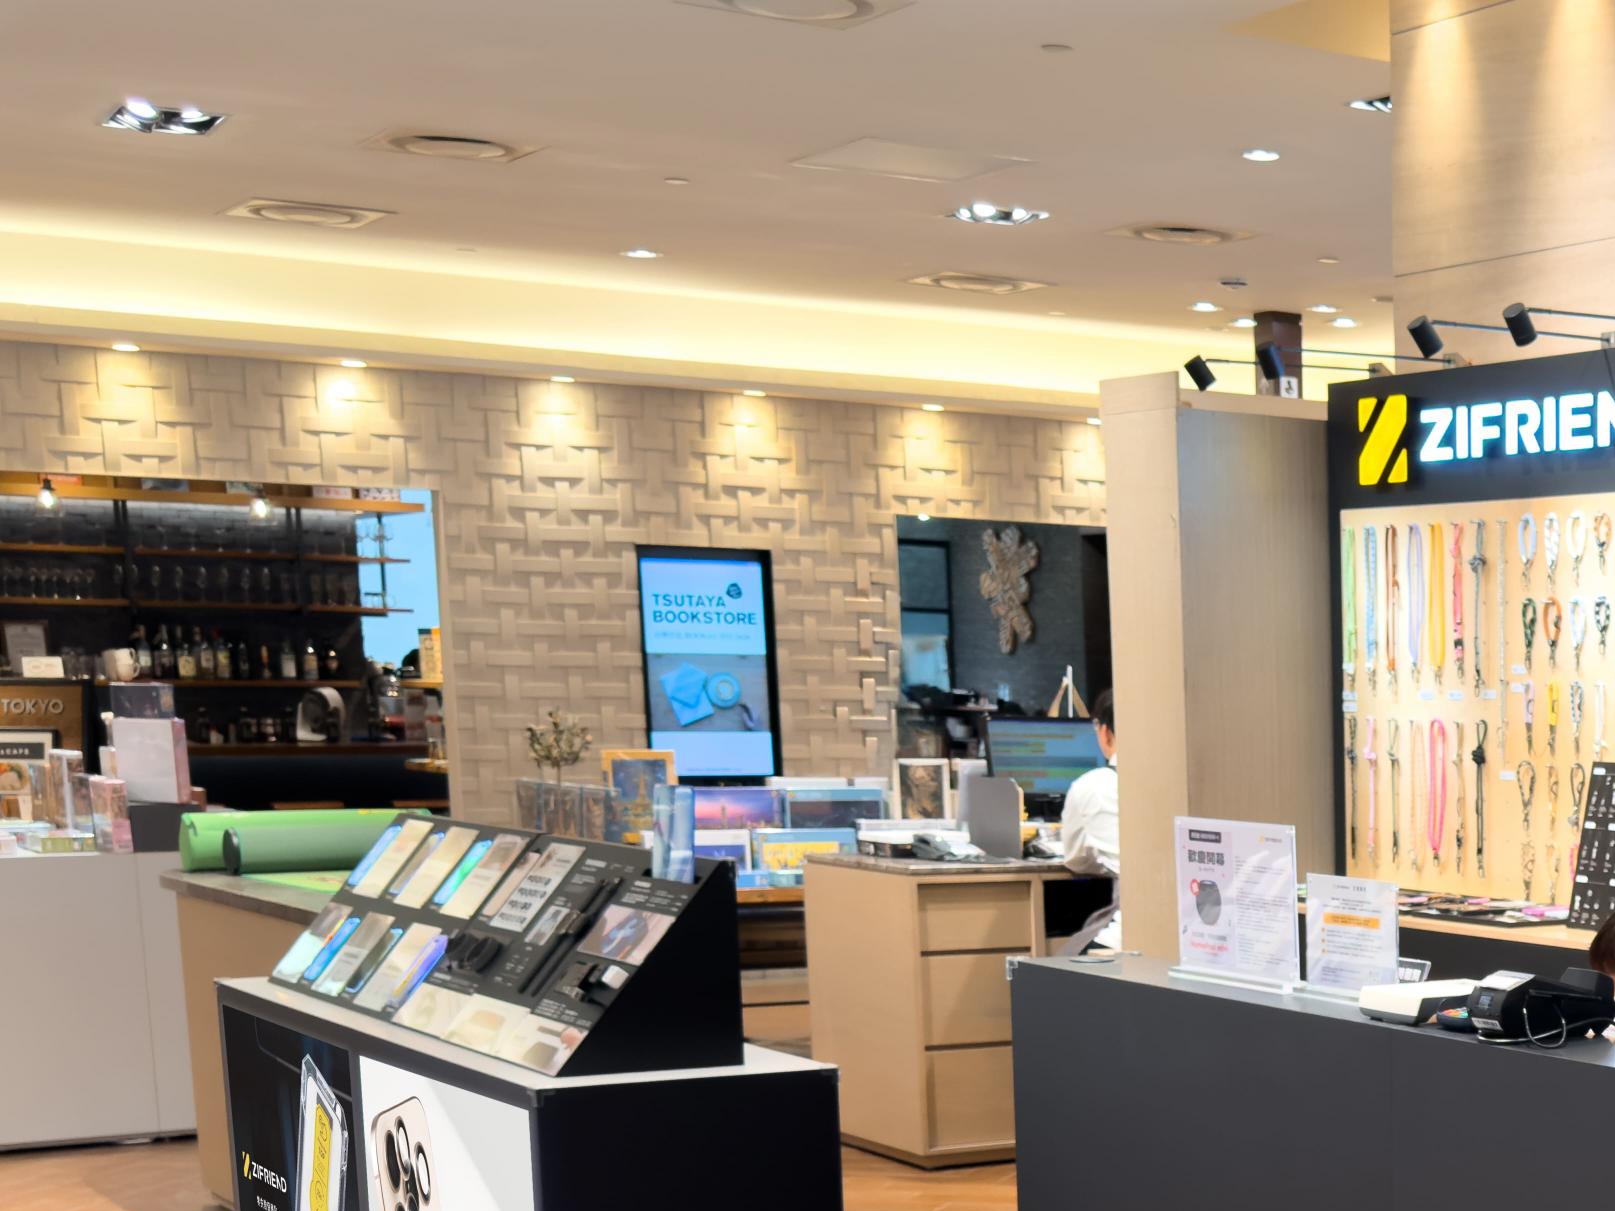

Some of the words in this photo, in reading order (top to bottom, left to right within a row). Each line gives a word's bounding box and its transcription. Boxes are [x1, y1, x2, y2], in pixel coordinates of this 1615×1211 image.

[652, 592, 726, 608] TSUTAYA
[652, 610, 757, 625] BOOKSTORE
[1, 698, 64, 714] TOKYO
[251, 1161, 287, 1193] ZIFRIEND
